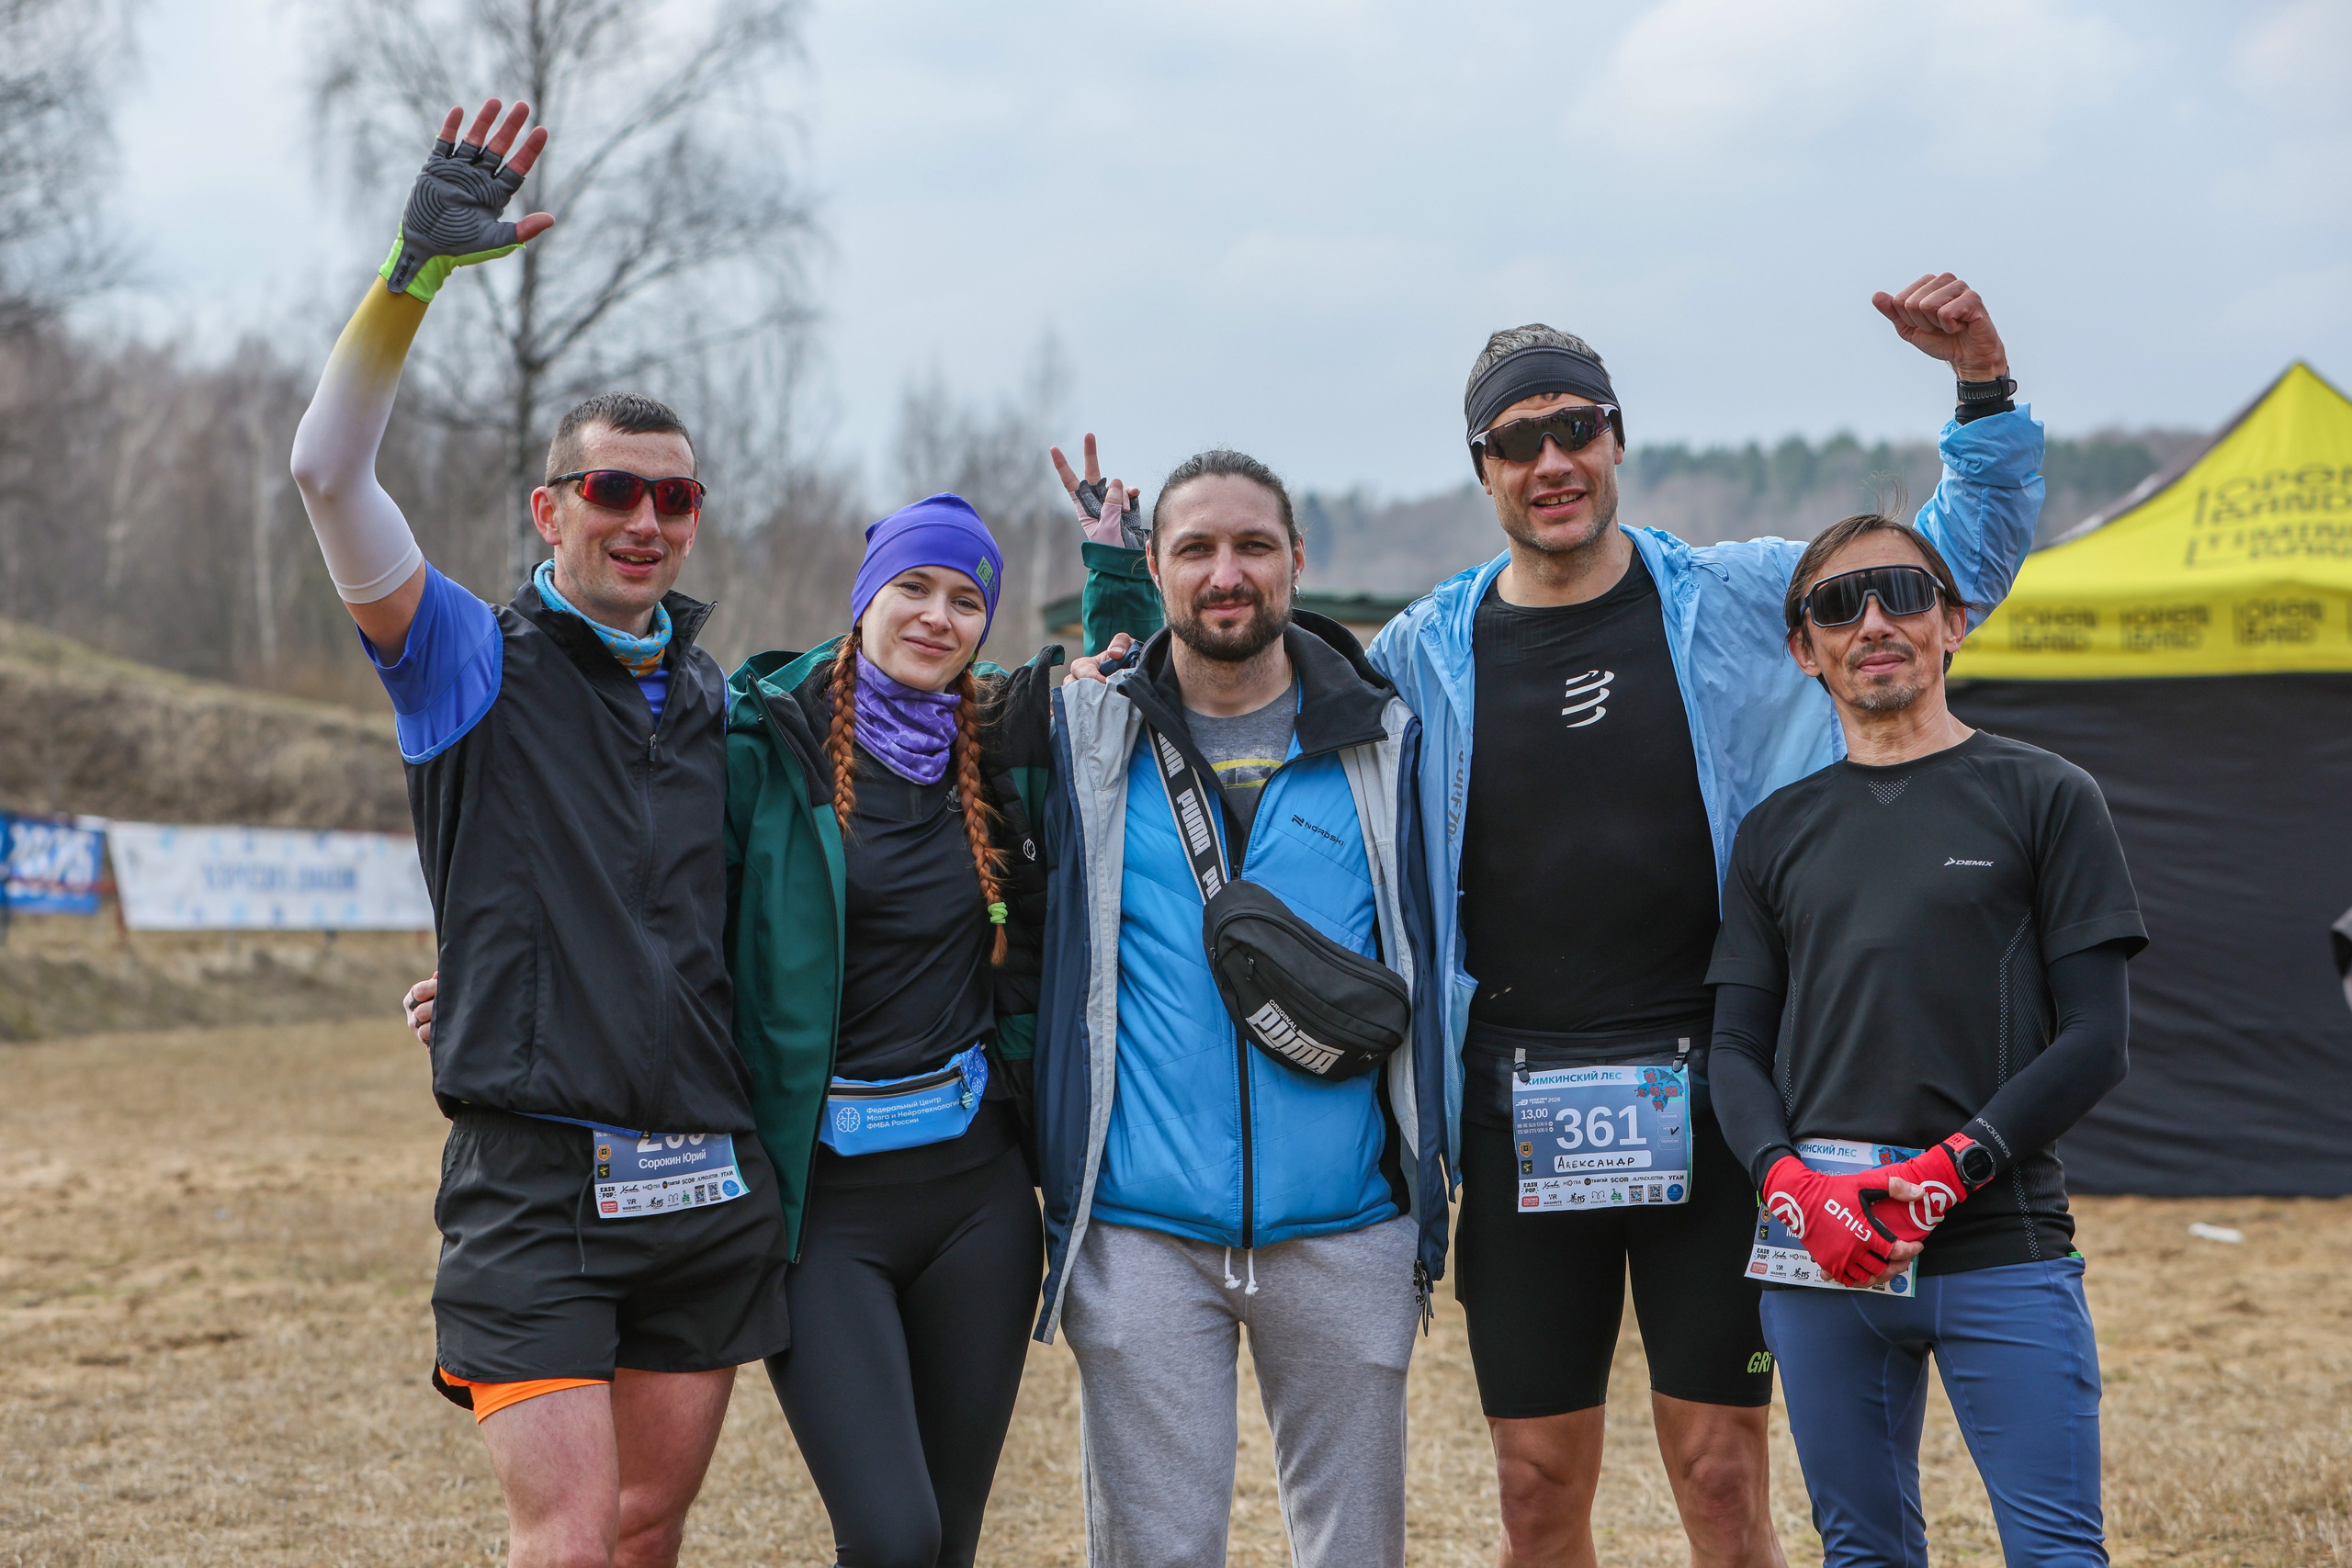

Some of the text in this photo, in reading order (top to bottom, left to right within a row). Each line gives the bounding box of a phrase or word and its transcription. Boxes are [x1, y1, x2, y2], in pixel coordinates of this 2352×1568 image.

[1176, 787, 1211, 857] PUMA
[1305, 821, 1344, 847] NORDSKI
[1955, 859, 1994, 867] DEMIX
[1202, 864, 1222, 899] PU
[1269, 998, 1297, 1032] ORIGINAL
[1247, 1002, 1340, 1075] PUMA
[1525, 1070, 1623, 1086] ХИМКИНСКИЙ ЛЕС
[866, 1097, 942, 1113] Федеральный Центр
[866, 1113, 889, 1122] Мозга
[866, 1118, 919, 1130] ФМБА России
[1555, 1105, 1647, 1150] 361
[1976, 1117, 2012, 1158] ROCKBROS
[638, 1148, 707, 1170] Сорокин Юрий
[1837, 1147, 1858, 1158] ЛЕС
